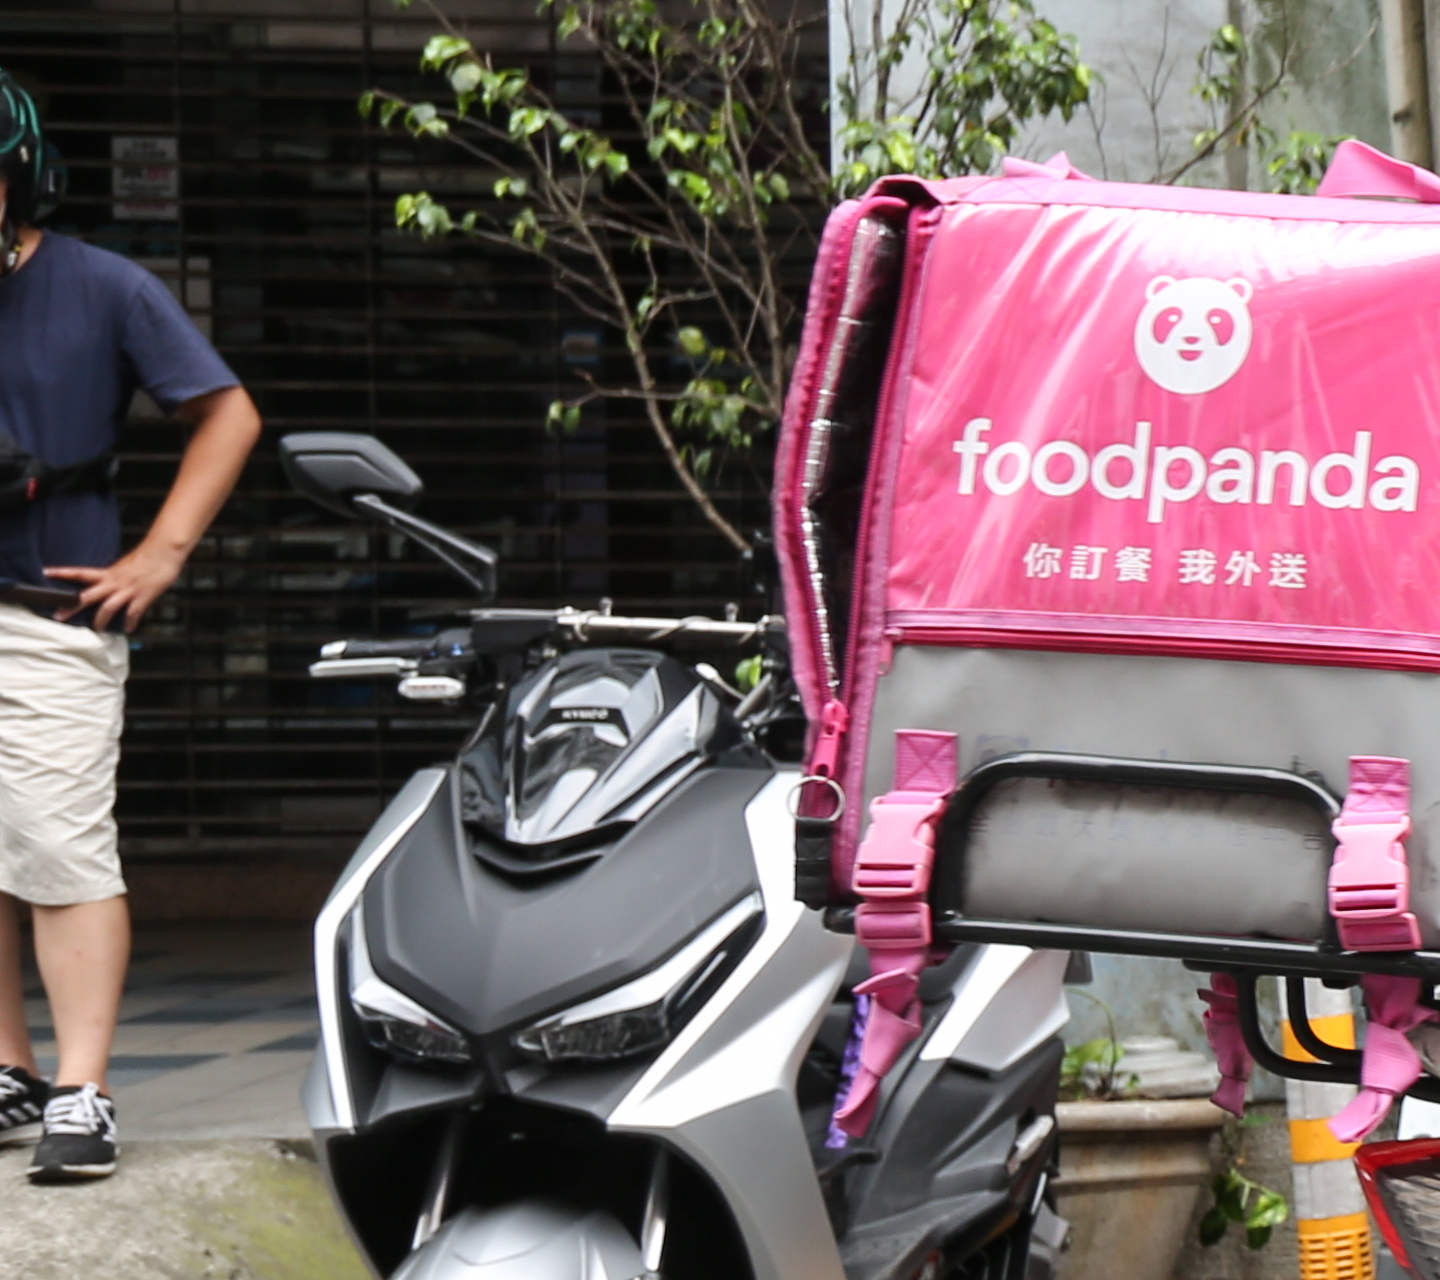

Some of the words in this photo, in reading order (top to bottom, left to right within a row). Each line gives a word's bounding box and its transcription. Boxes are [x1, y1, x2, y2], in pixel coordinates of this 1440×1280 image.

[952, 416, 1422, 524] foodpanda
[1022, 542, 1153, 584] 你訂餐
[1178, 548, 1308, 589] 我外送
